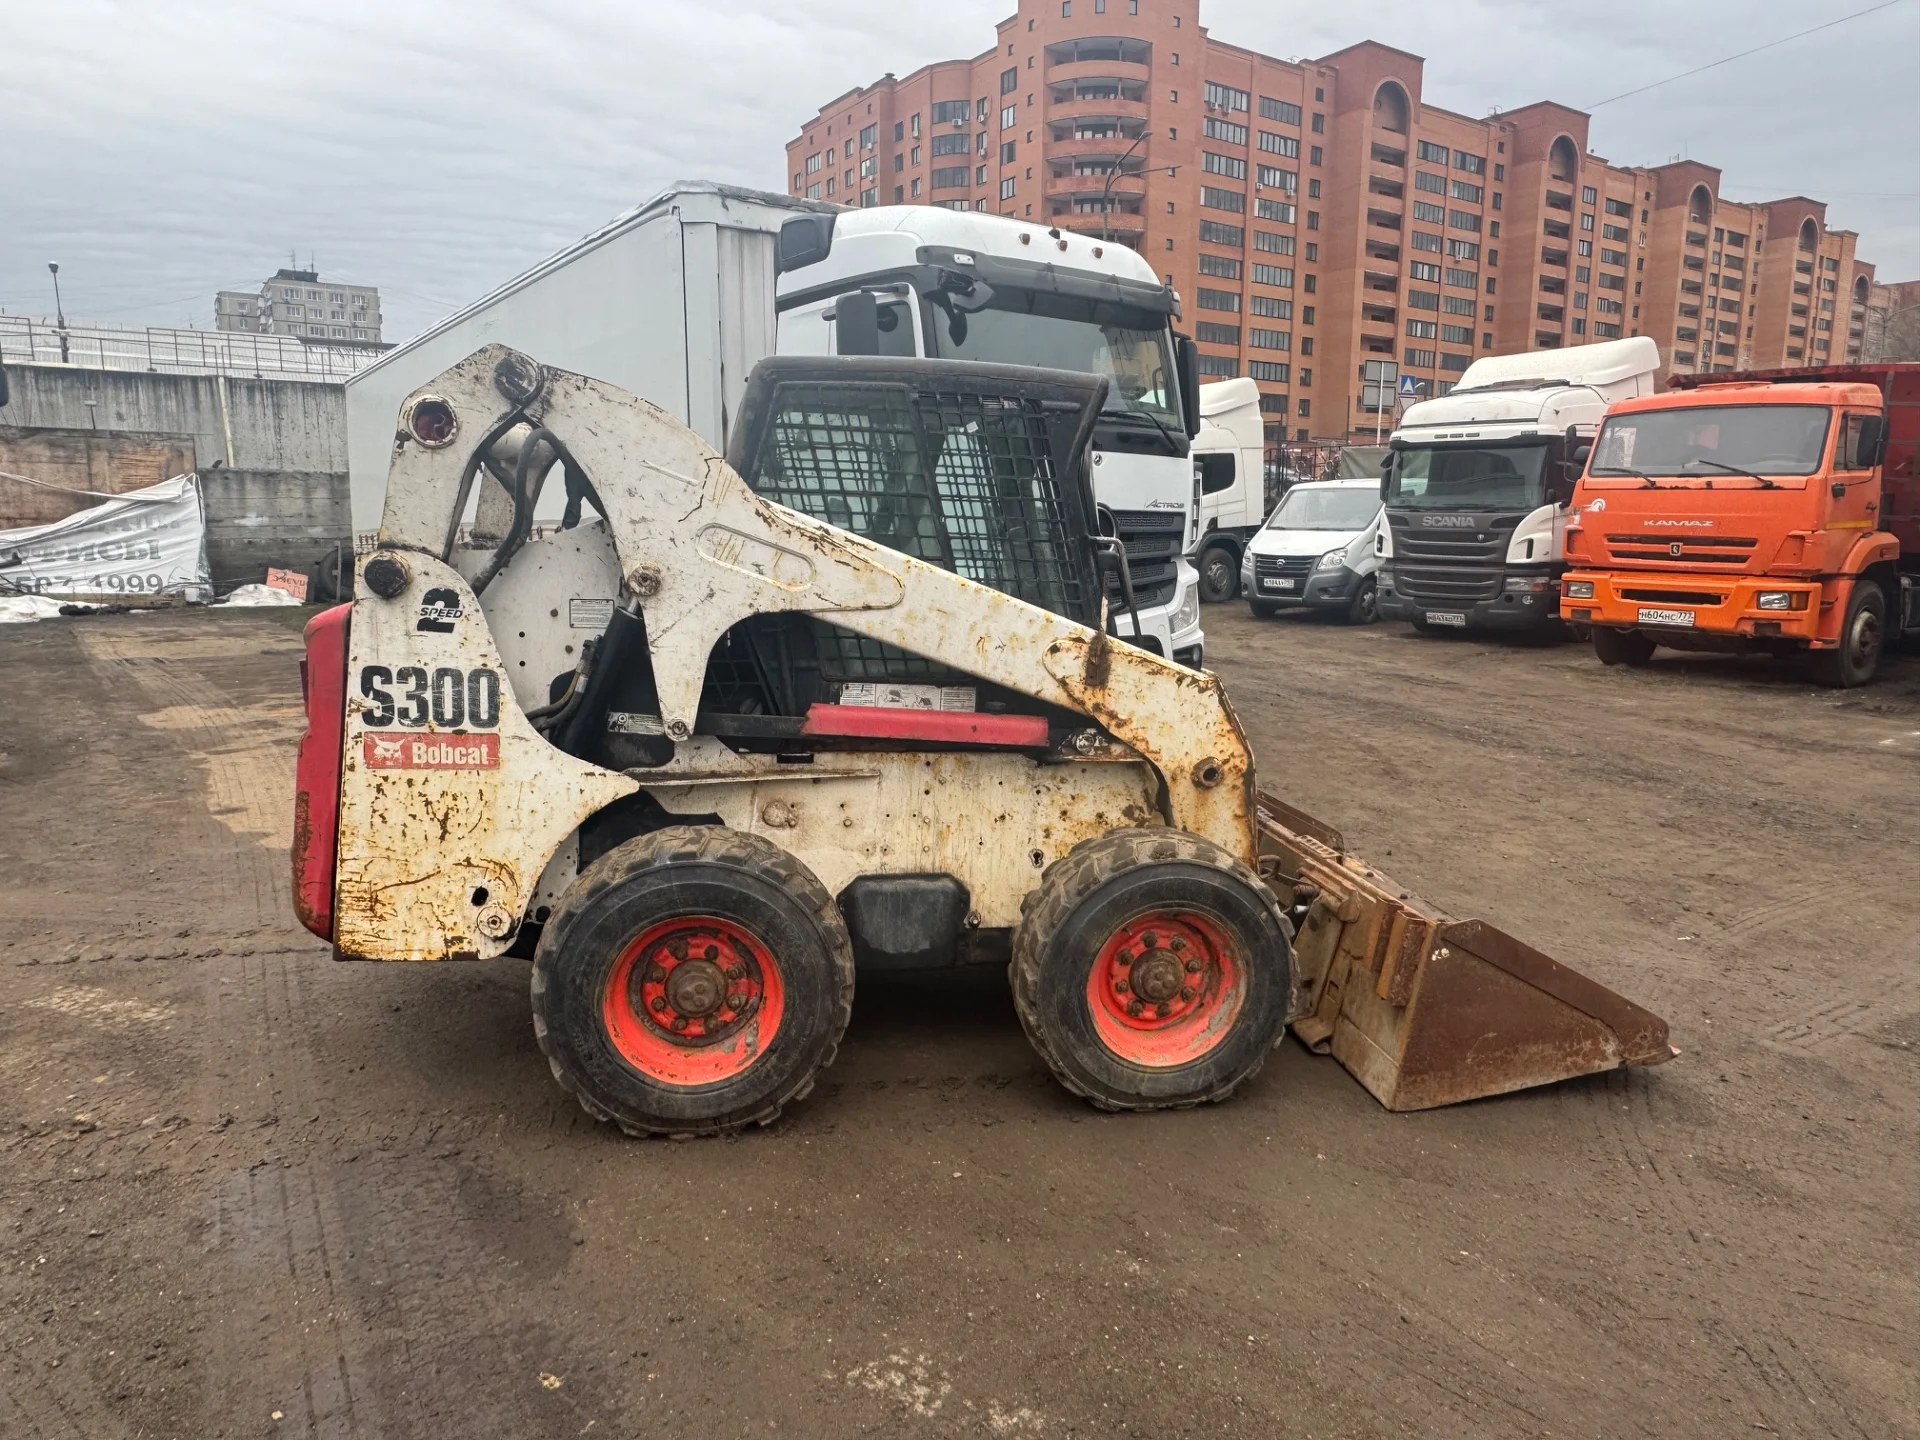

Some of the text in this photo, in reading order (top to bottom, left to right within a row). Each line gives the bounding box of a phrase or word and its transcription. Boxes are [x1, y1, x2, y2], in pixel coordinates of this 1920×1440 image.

[1421, 516, 1475, 528] SCANIA
[419, 607, 464, 619] SPEED
[361, 665, 501, 729] S300
[412, 742, 490, 765] Bobcat
